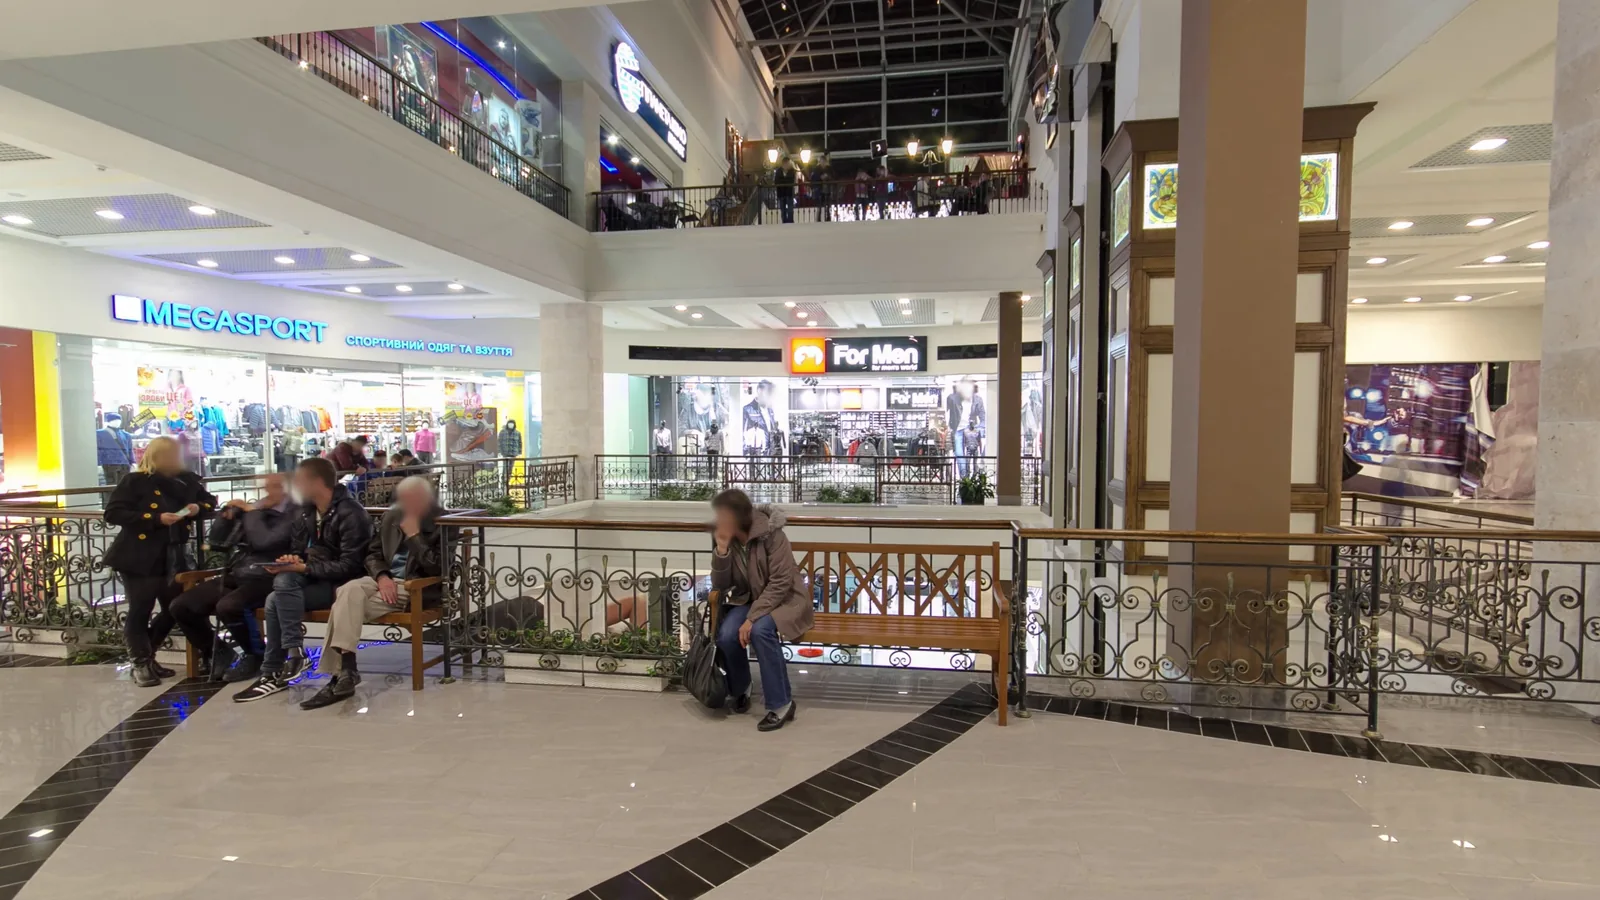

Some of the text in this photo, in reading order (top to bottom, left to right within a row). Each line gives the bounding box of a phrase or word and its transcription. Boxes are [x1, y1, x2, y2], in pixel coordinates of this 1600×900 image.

[143, 298, 329, 343] MEGASPORT
[345, 335, 513, 357] СПОРТИВНИЙ ОДЯГ ТА ВЗУТТЯ
[833, 343, 919, 365] For Men
[890, 392, 911, 404] For
